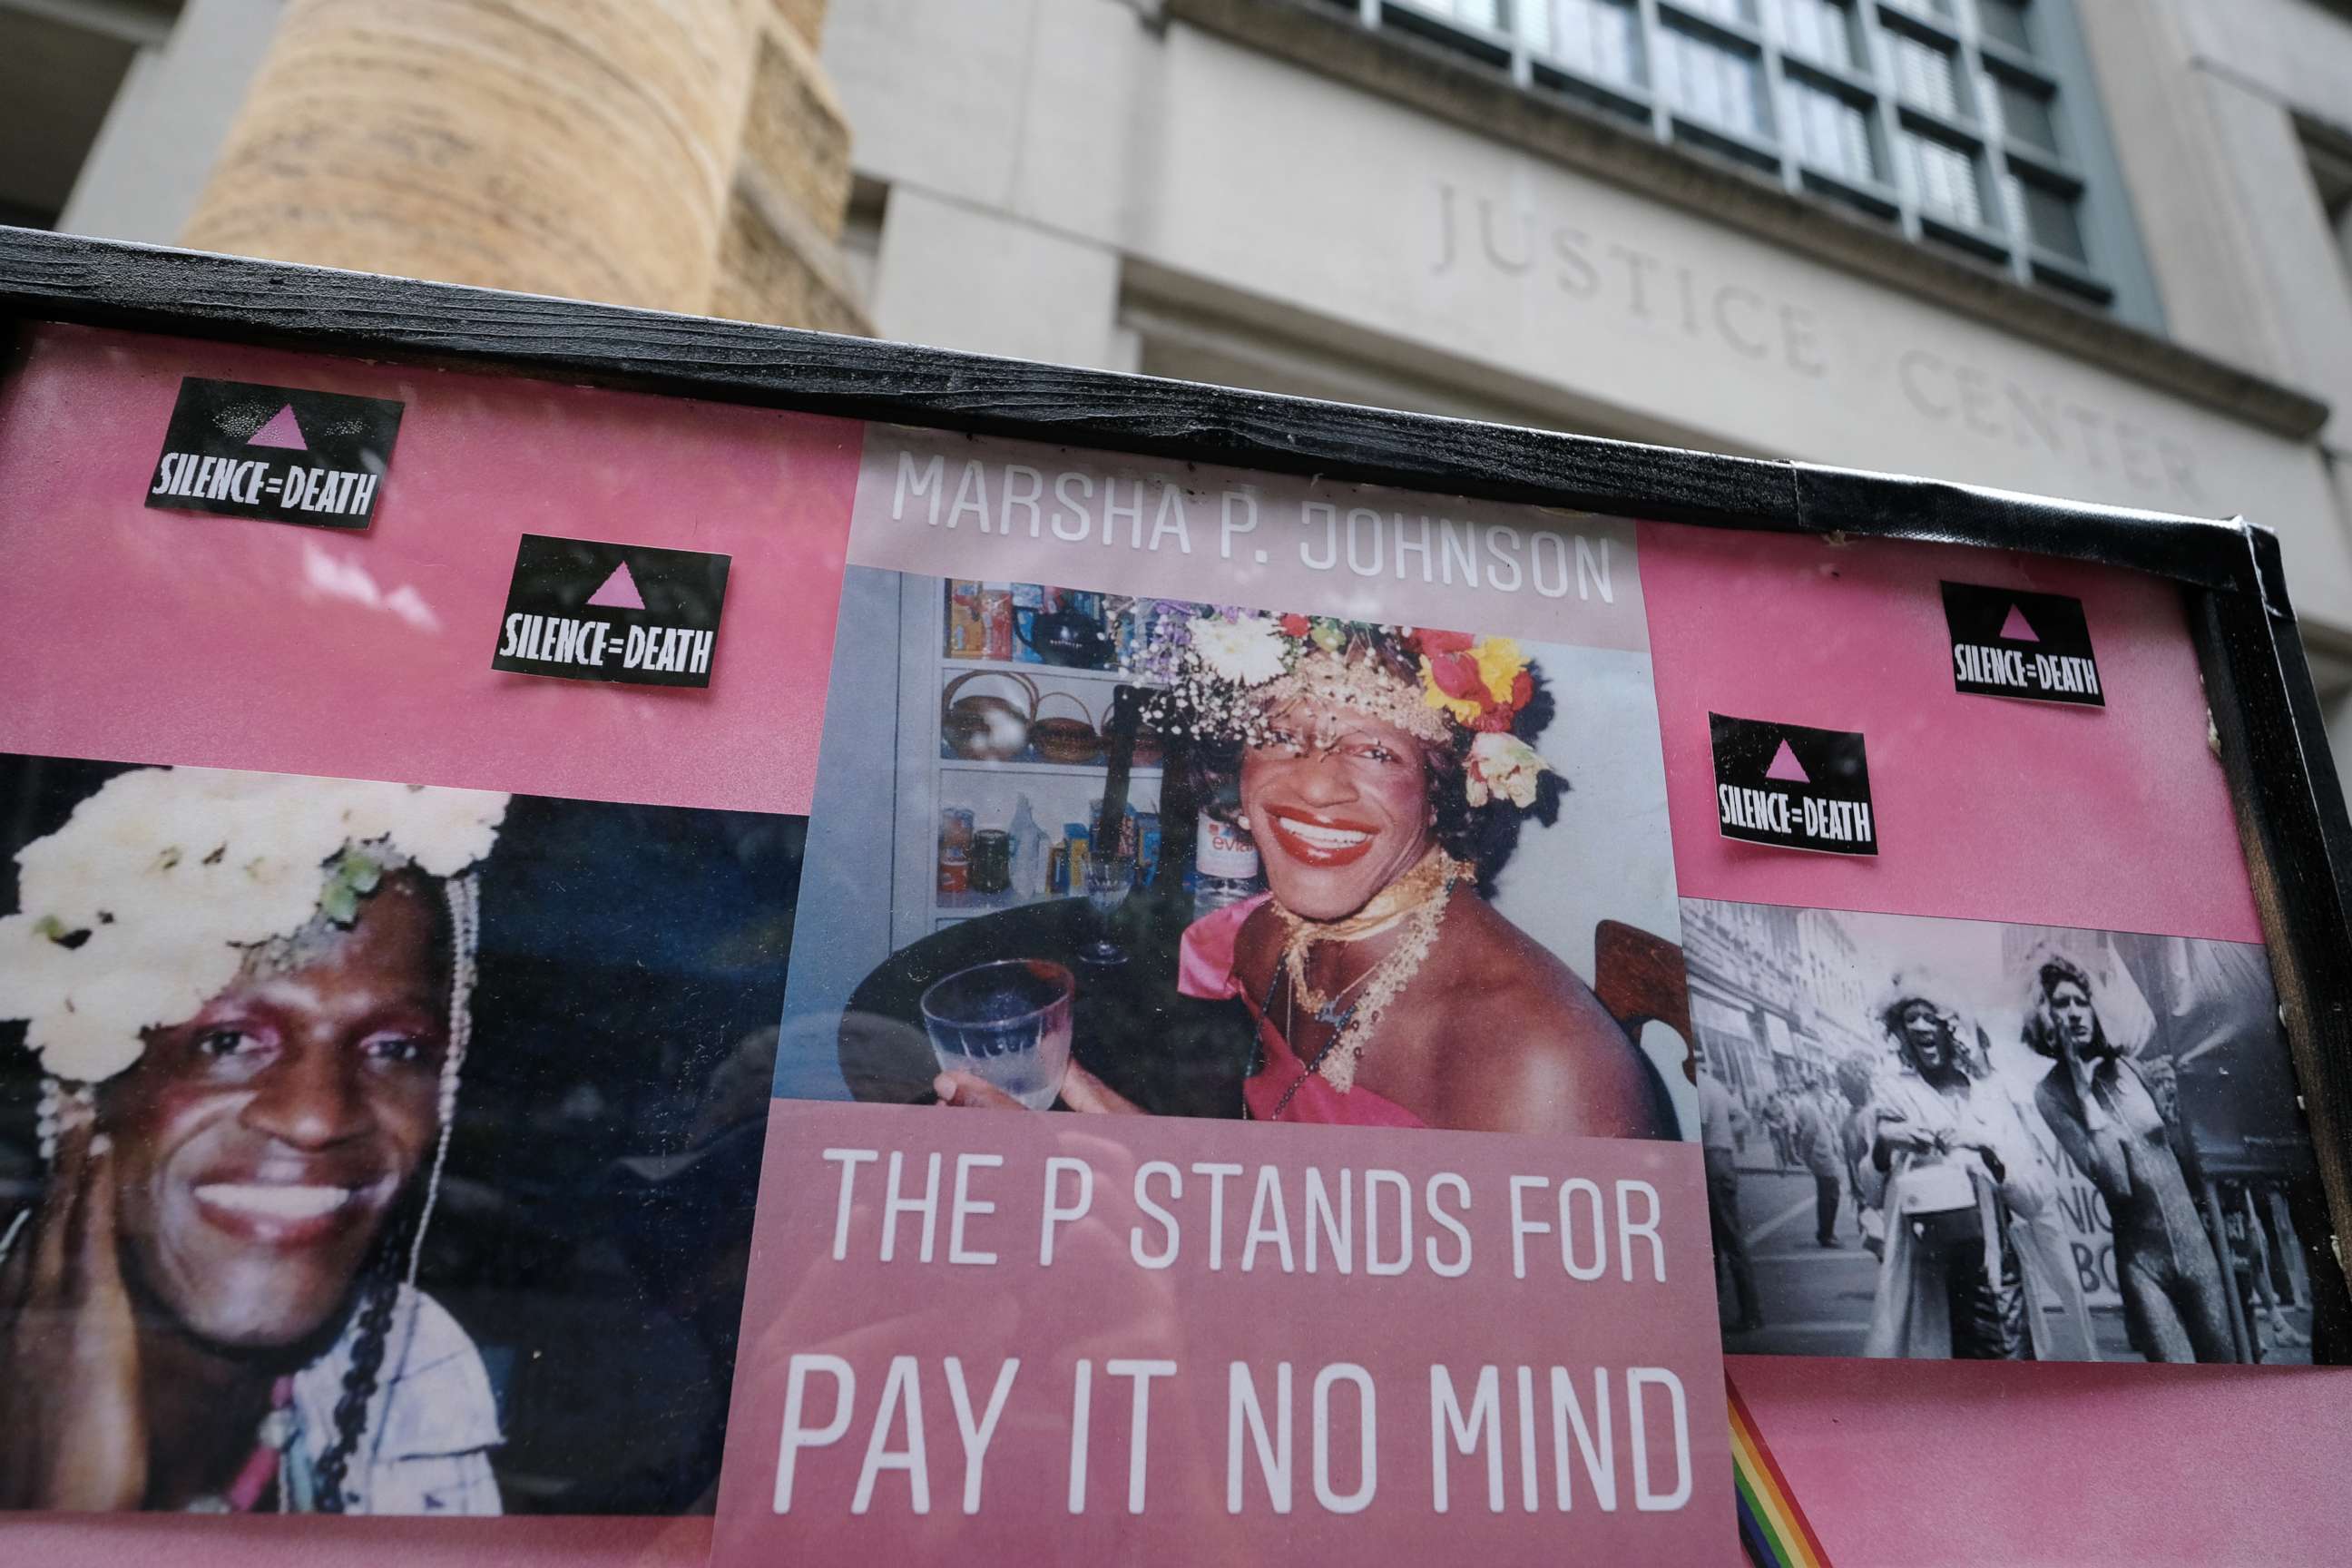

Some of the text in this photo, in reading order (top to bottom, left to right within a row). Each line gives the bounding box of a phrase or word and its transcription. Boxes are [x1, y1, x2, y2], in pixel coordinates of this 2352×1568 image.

[1429, 184, 2206, 506] JUSTICE CENTER
[152, 452, 378, 515] SILENCE=DEATH
[892, 450, 1614, 604] MARSHA P. JOHNSON
[499, 612, 714, 673] SILENCE=DEATH
[1955, 643, 2099, 694] SILENCE=DEATH
[1719, 783, 1872, 842] SILENCE=DEATH
[823, 1148, 1666, 1282] THE P STANDS FOR
[774, 1354, 1691, 1514] PAY IT NO MIND
